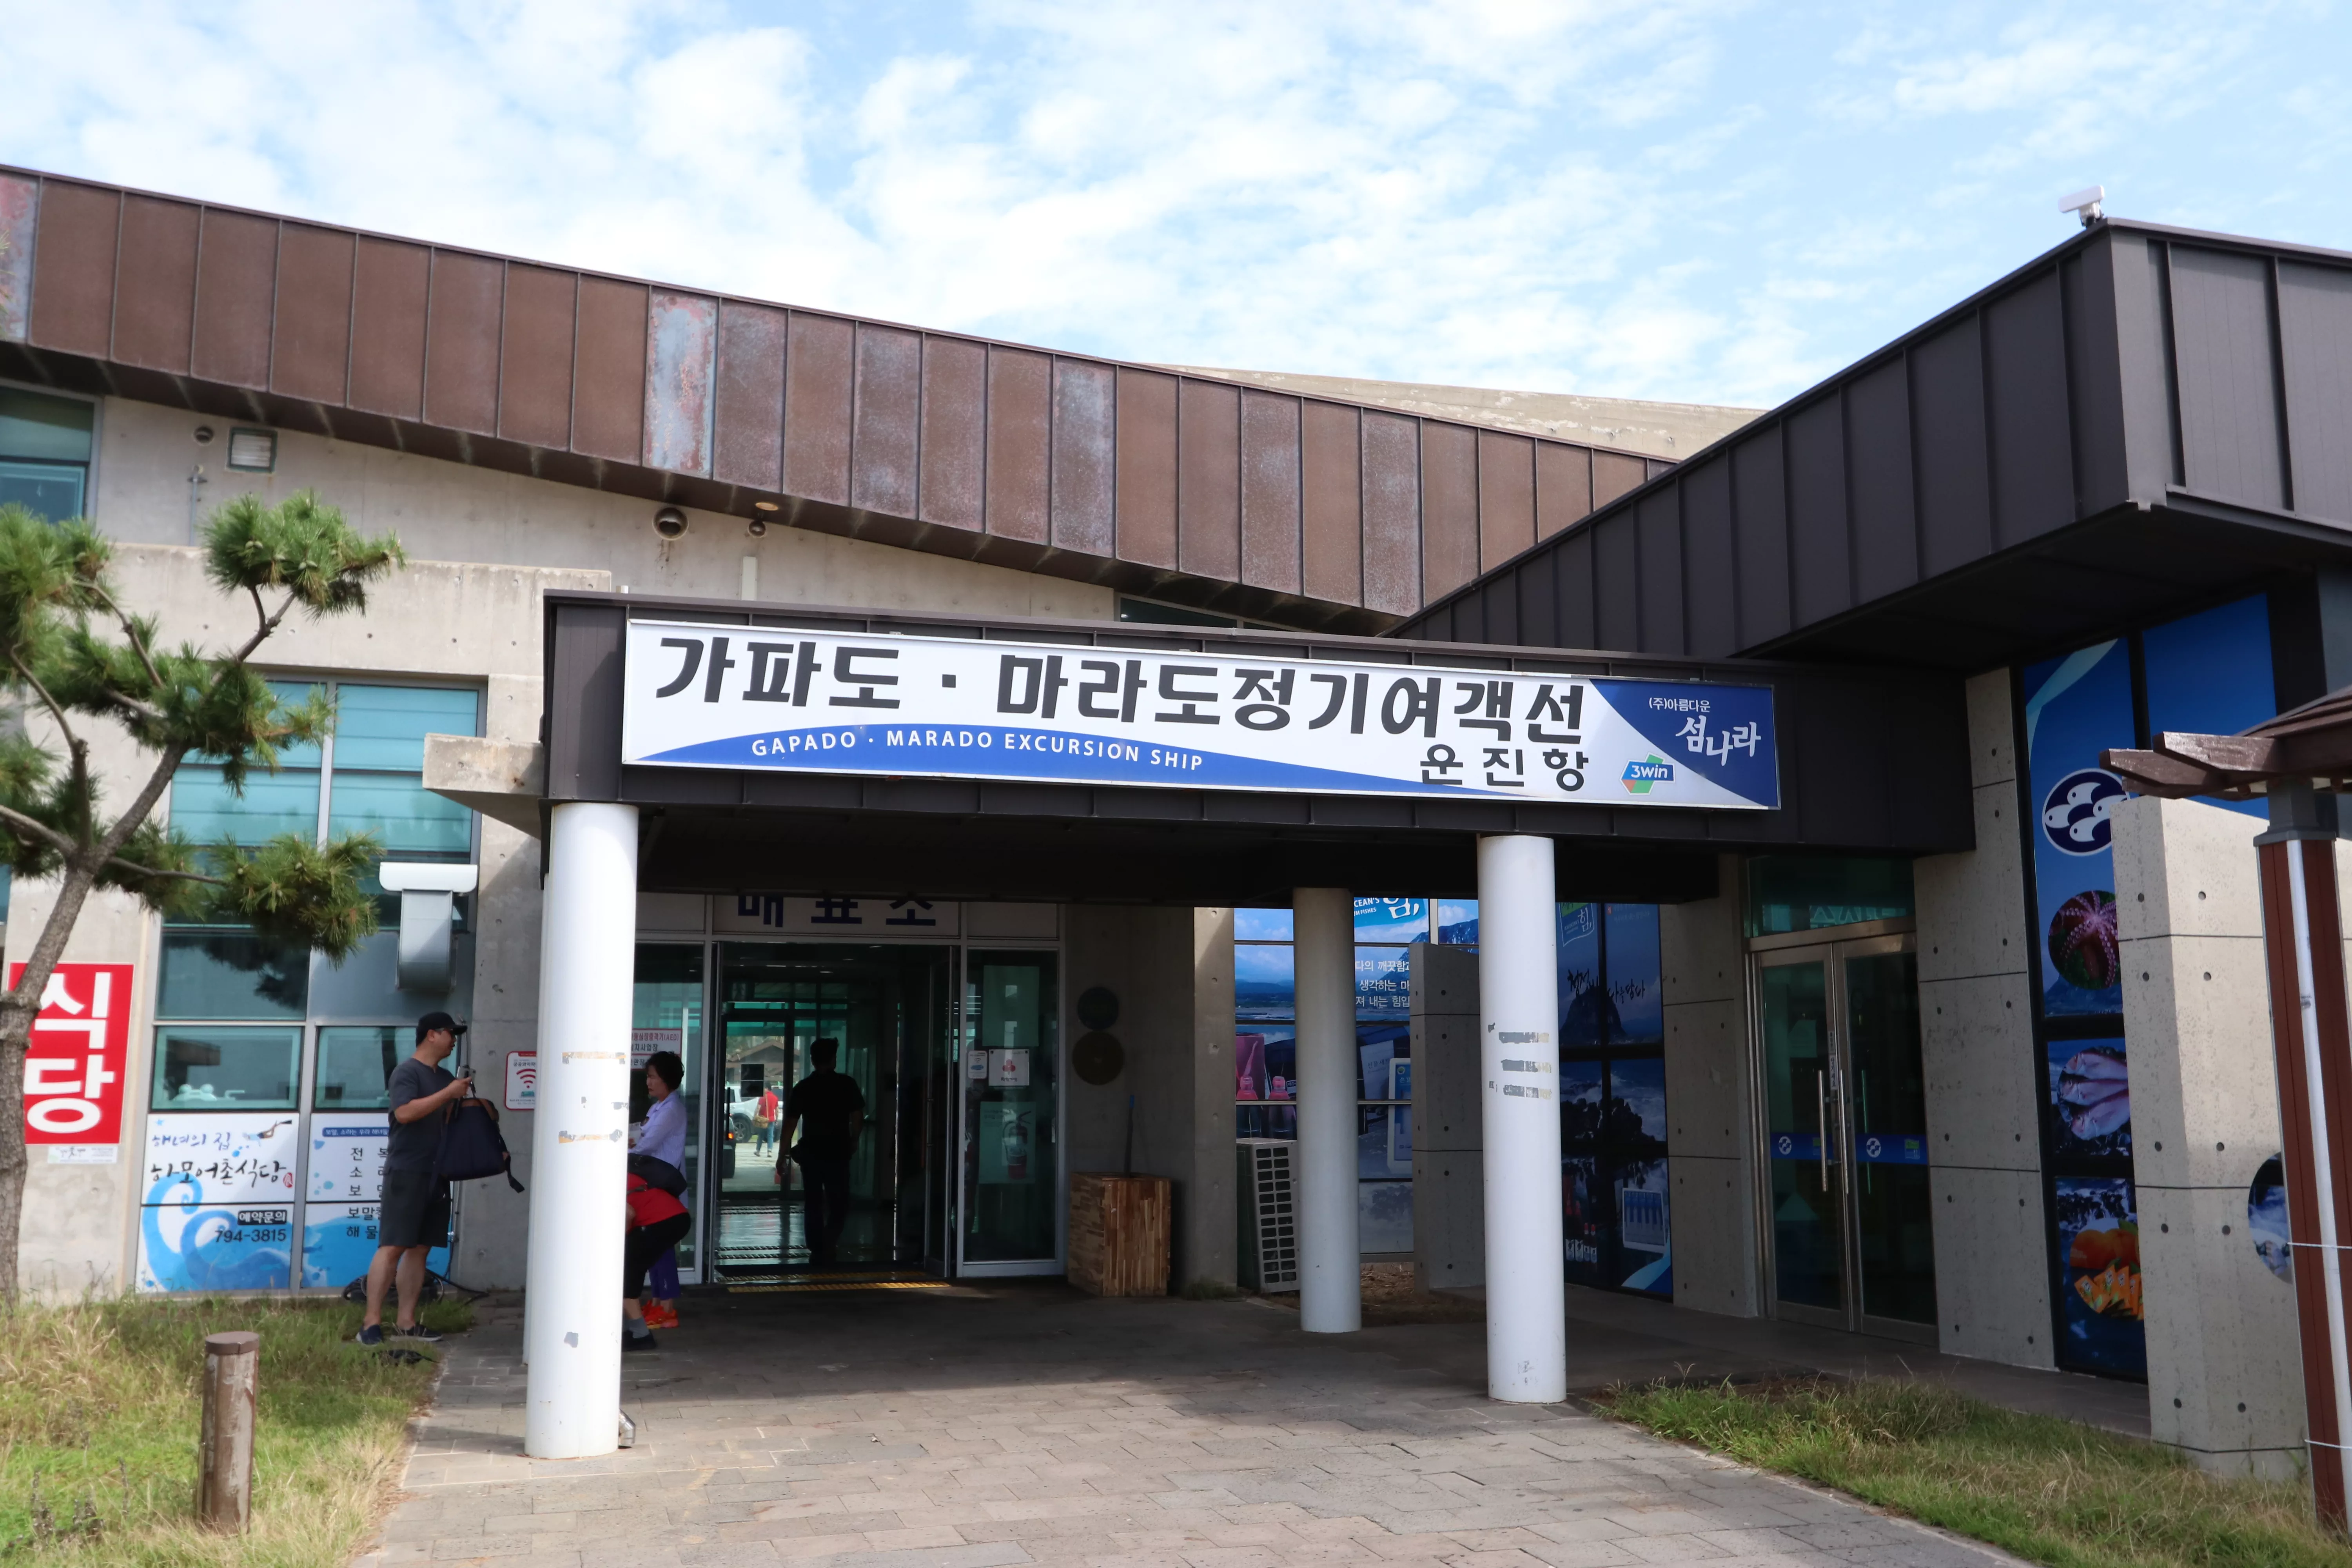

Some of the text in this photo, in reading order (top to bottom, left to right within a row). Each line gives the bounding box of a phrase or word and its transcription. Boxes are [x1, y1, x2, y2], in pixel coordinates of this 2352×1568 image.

[656, 637, 900, 709] 가파도
[996, 654, 1584, 744] 마라도정기여객선
[1649, 697, 1711, 713] (주)아름다운
[1675, 715, 1761, 766] 섬나라
[751, 731, 855, 756] GAPADO
[887, 730, 992, 748] MARADO
[1005, 733, 1139, 762] EXCURSION
[1150, 749, 1202, 771] SHIP
[1419, 744, 1589, 792] 운진항
[1631, 764, 1668, 779] 3win
[1353, 897, 1380, 907] CEAN'S
[1359, 980, 1397, 992] 생각하는
[1369, 995, 1388, 1007] 내는
[632, 1033, 679, 1042] 동심장충격기(AED)
[23, 972, 114, 1134] 식당
[152, 1131, 230, 1151] 해녀의 집
[151, 1158, 287, 1188] 하모어촌식당
[238, 1211, 285, 1223] 예약문의
[215, 1229, 286, 1243] 794-3815
